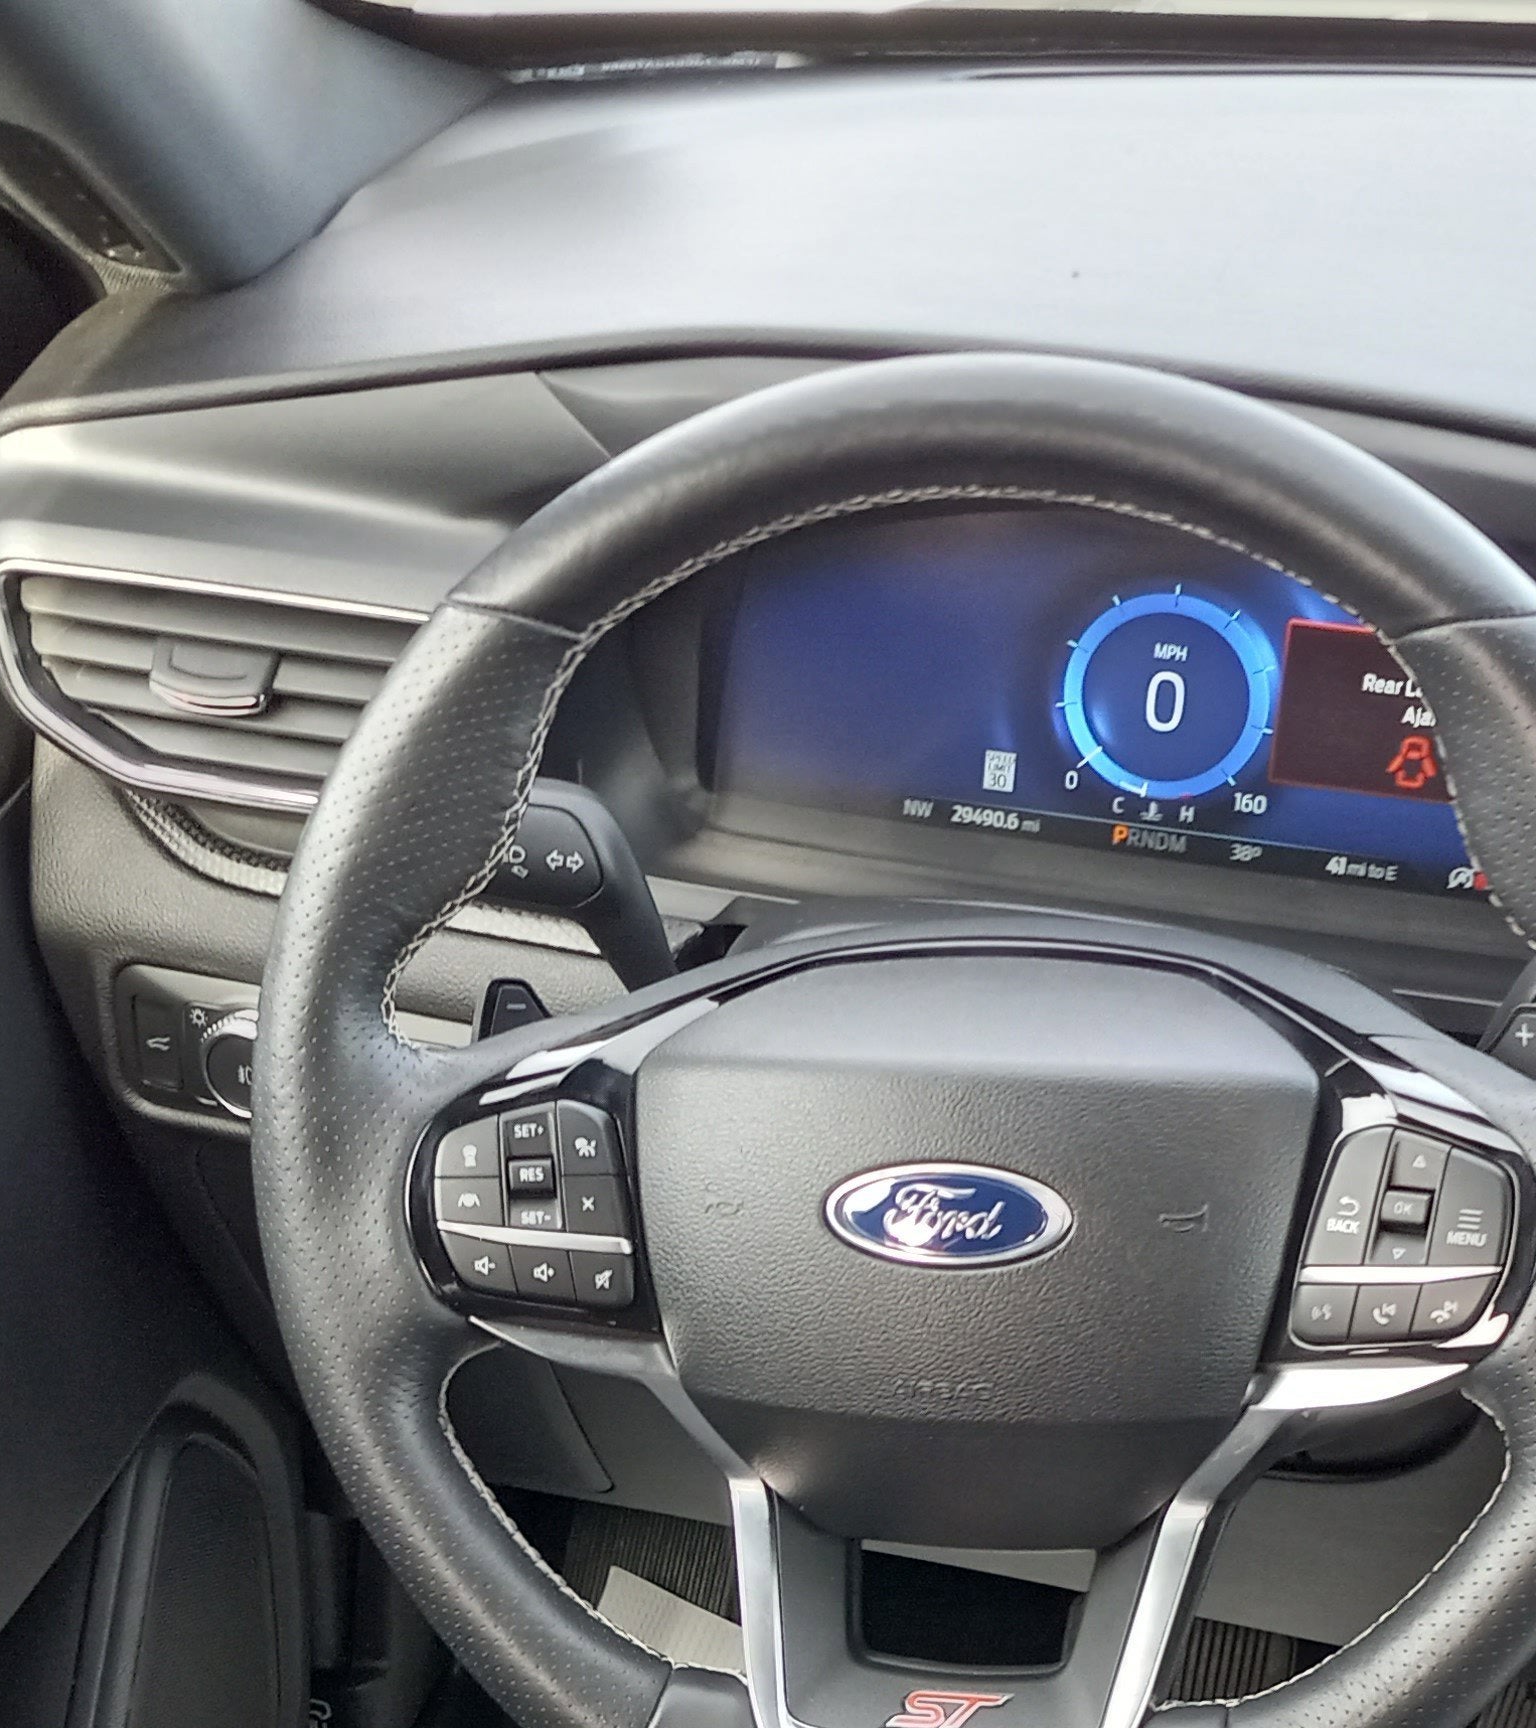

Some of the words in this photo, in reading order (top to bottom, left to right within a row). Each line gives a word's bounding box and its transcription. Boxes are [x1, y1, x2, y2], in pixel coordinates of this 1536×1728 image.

[1153, 641, 1189, 662] MPH
[1362, 672, 1404, 696] Rear
[1145, 670, 1186, 733] 0
[989, 773, 1008, 789] 30
[1065, 770, 1079, 790] 0
[1112, 797, 1126, 815] C
[1178, 805, 1196, 823] H
[1233, 793, 1268, 815] 160
[902, 799, 934, 818] NW
[950, 804, 1021, 831] 29490.6
[1325, 856, 1348, 876] 41
[519, 1167, 545, 1183] RES
[882, 1184, 1006, 1246] Ford
[1393, 1201, 1414, 1215] OK
[1326, 1218, 1361, 1235] BACK
[1446, 1231, 1488, 1248] MENU
